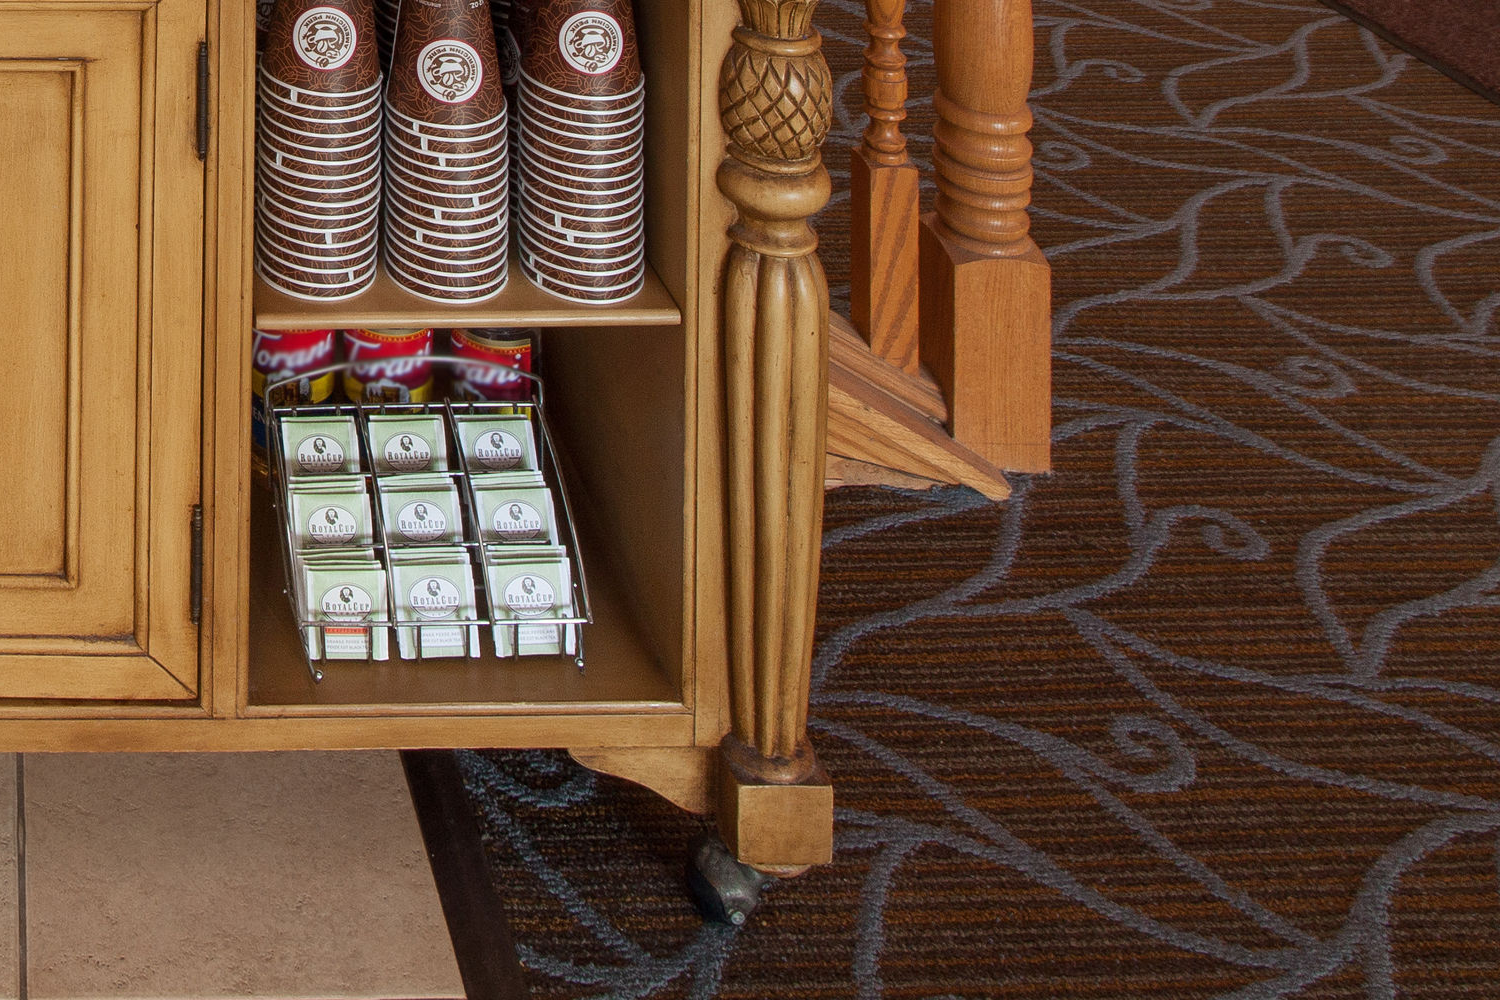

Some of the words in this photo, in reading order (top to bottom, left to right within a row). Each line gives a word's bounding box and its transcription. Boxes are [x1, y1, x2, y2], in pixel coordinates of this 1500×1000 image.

[570, 19, 589, 33] PERK
[592, 19, 616, 52] AMERICINN
[427, 47, 447, 61] PERK
[450, 47, 475, 81] AMERICINN
